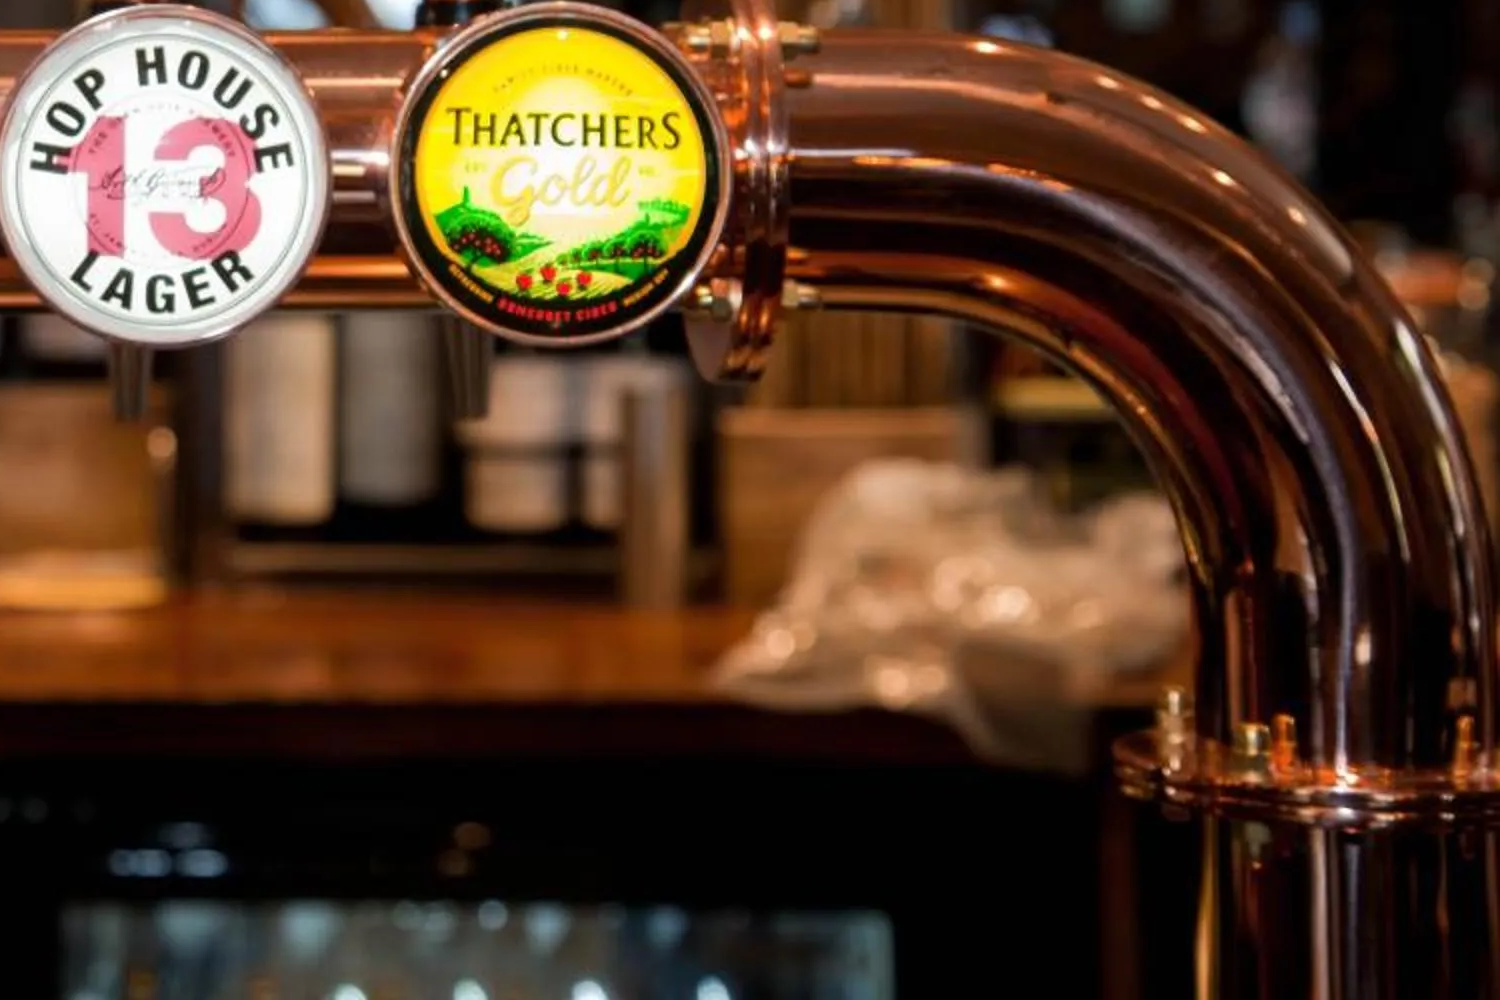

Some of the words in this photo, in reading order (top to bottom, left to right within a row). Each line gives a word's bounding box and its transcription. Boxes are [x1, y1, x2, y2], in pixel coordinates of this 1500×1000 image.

[28, 67, 106, 176] HOP
[134, 45, 295, 174] HOUSE
[66, 115, 263, 261] 13
[490, 155, 632, 227] Gold
[69, 249, 255, 314] LAGER
